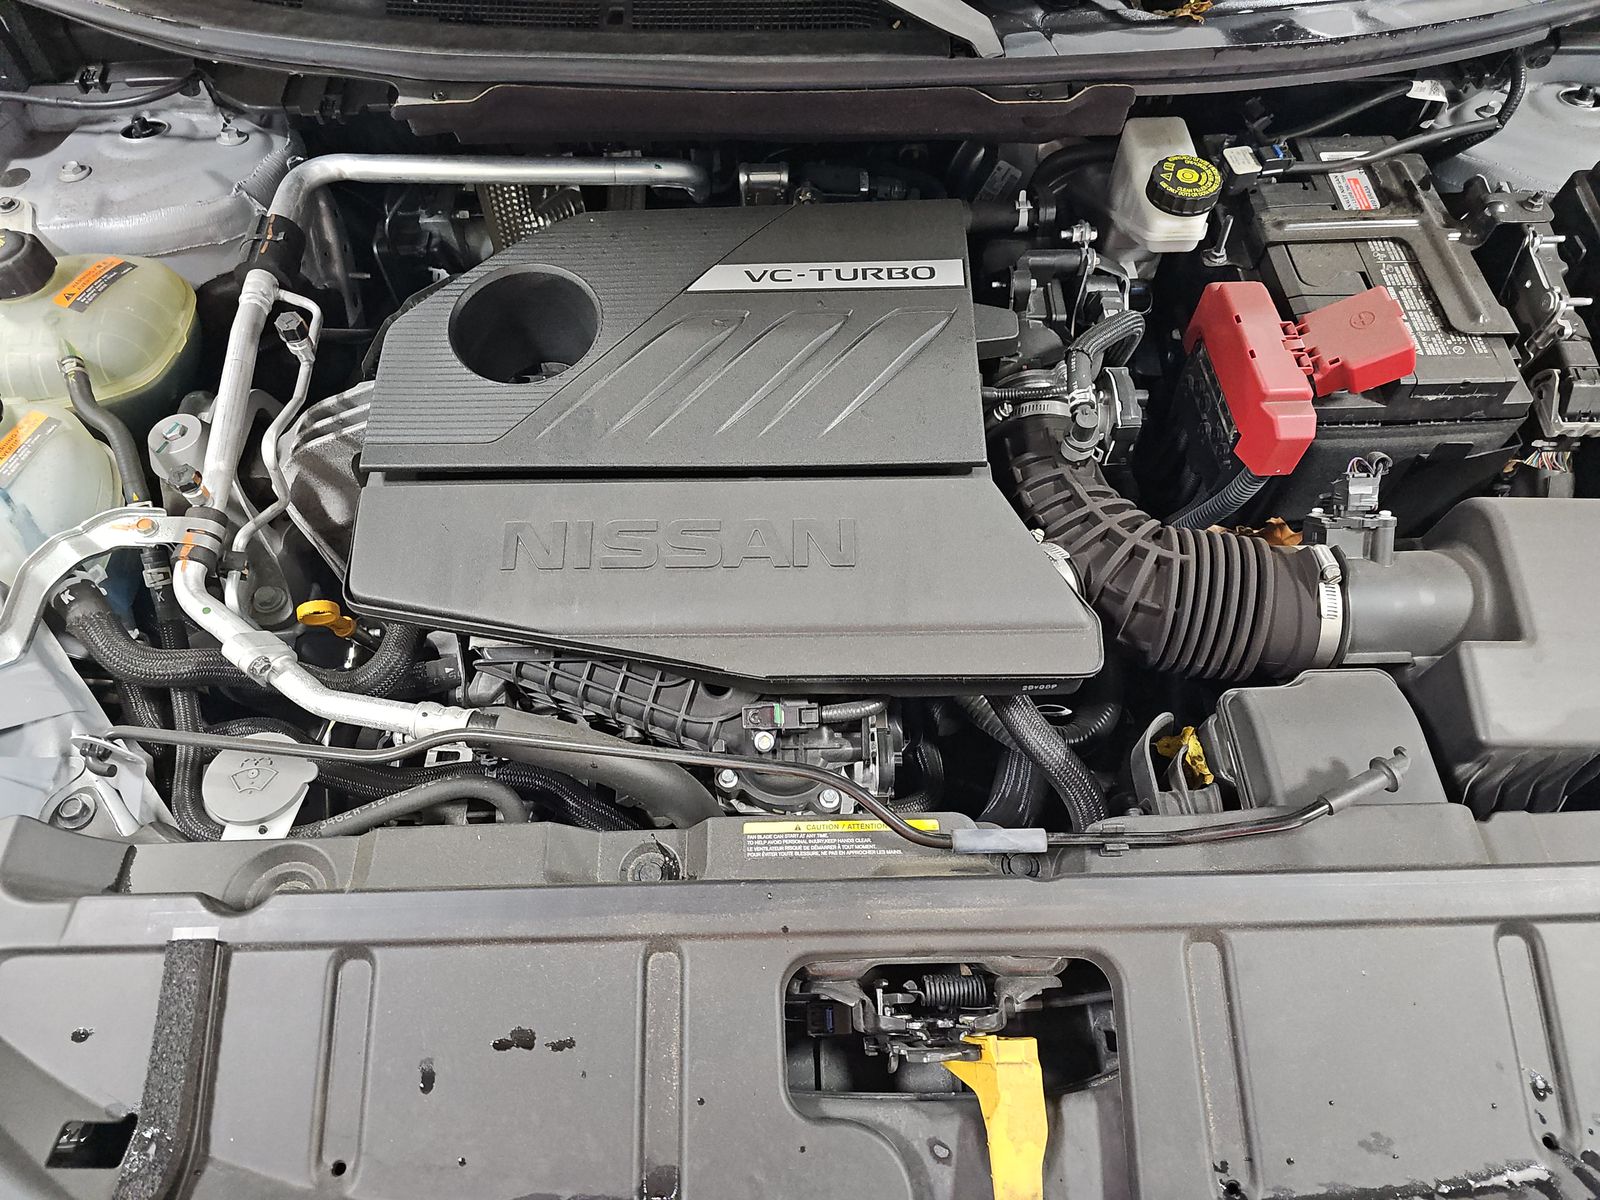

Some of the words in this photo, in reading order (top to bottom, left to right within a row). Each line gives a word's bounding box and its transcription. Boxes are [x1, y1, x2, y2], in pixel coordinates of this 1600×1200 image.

[744, 266, 936, 283] VC-TURBO
[500, 518, 856, 571] NISSAN
[60, 589, 75, 604] K
[155, 590, 165, 602] K
